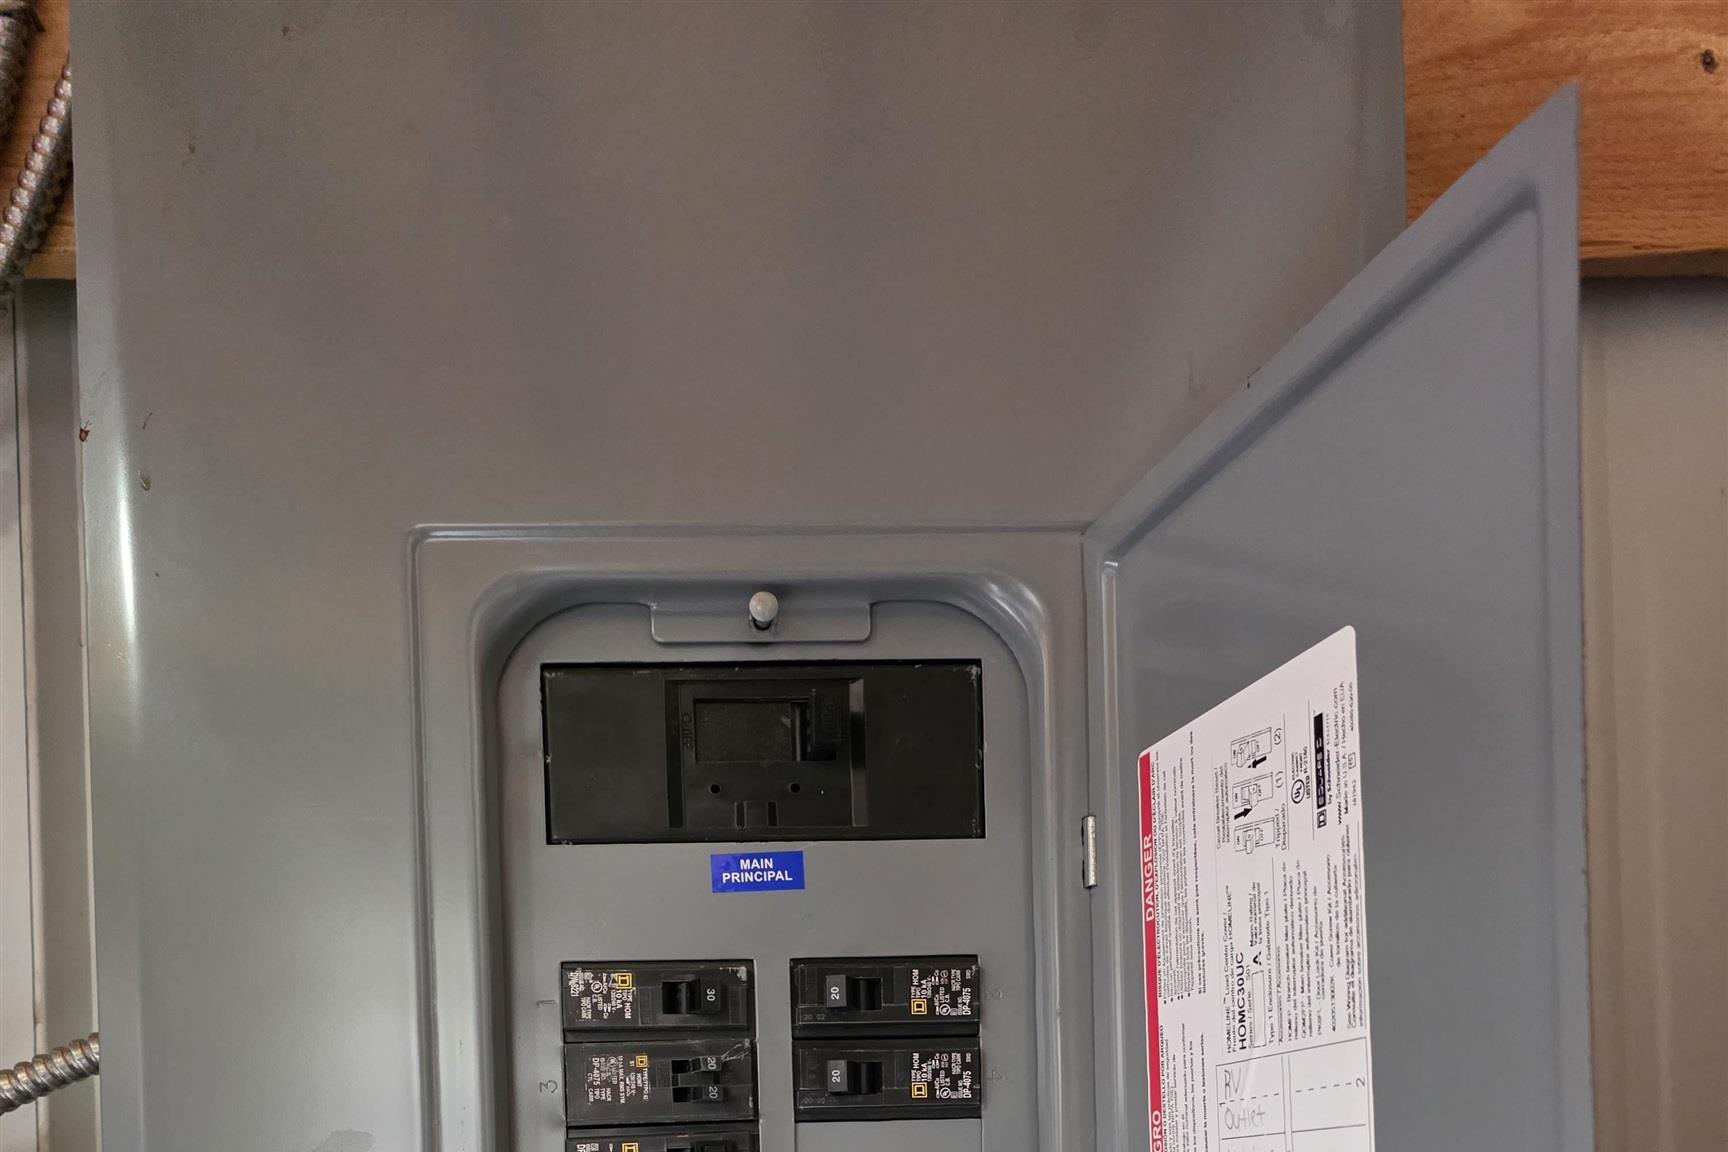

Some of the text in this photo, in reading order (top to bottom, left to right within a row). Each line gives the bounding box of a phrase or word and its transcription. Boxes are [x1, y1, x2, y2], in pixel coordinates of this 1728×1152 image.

[1274, 728, 1282, 745] (2)
[1275, 771, 1283, 788] (1)
[740, 858, 773, 869] MAIN
[723, 870, 792, 883] PRINCIPAL
[1144, 833, 1154, 921] DANGER
[706, 988, 716, 1002] 30
[830, 986, 839, 1000] 20
[921, 980, 927, 998] 10 kA
[536, 999, 556, 1008] 1
[616, 990, 622, 1008] 10 kA
[962, 988, 971, 1015] DP-4075
[1236, 952, 1246, 1050] HOMC30UC
[592, 1058, 600, 1085] DP-4075
[707, 1056, 716, 1071] 20
[921, 1063, 928, 1081] 10 kA
[831, 1069, 840, 1083] 20
[963, 1071, 971, 1098] DP-4075
[1224, 1067, 1241, 1100] RV
[1356, 1077, 1366, 1087] 2
[539, 1079, 558, 1094] 3
[709, 1085, 718, 1100] 20
[1225, 1104, 1266, 1129] Outlet
